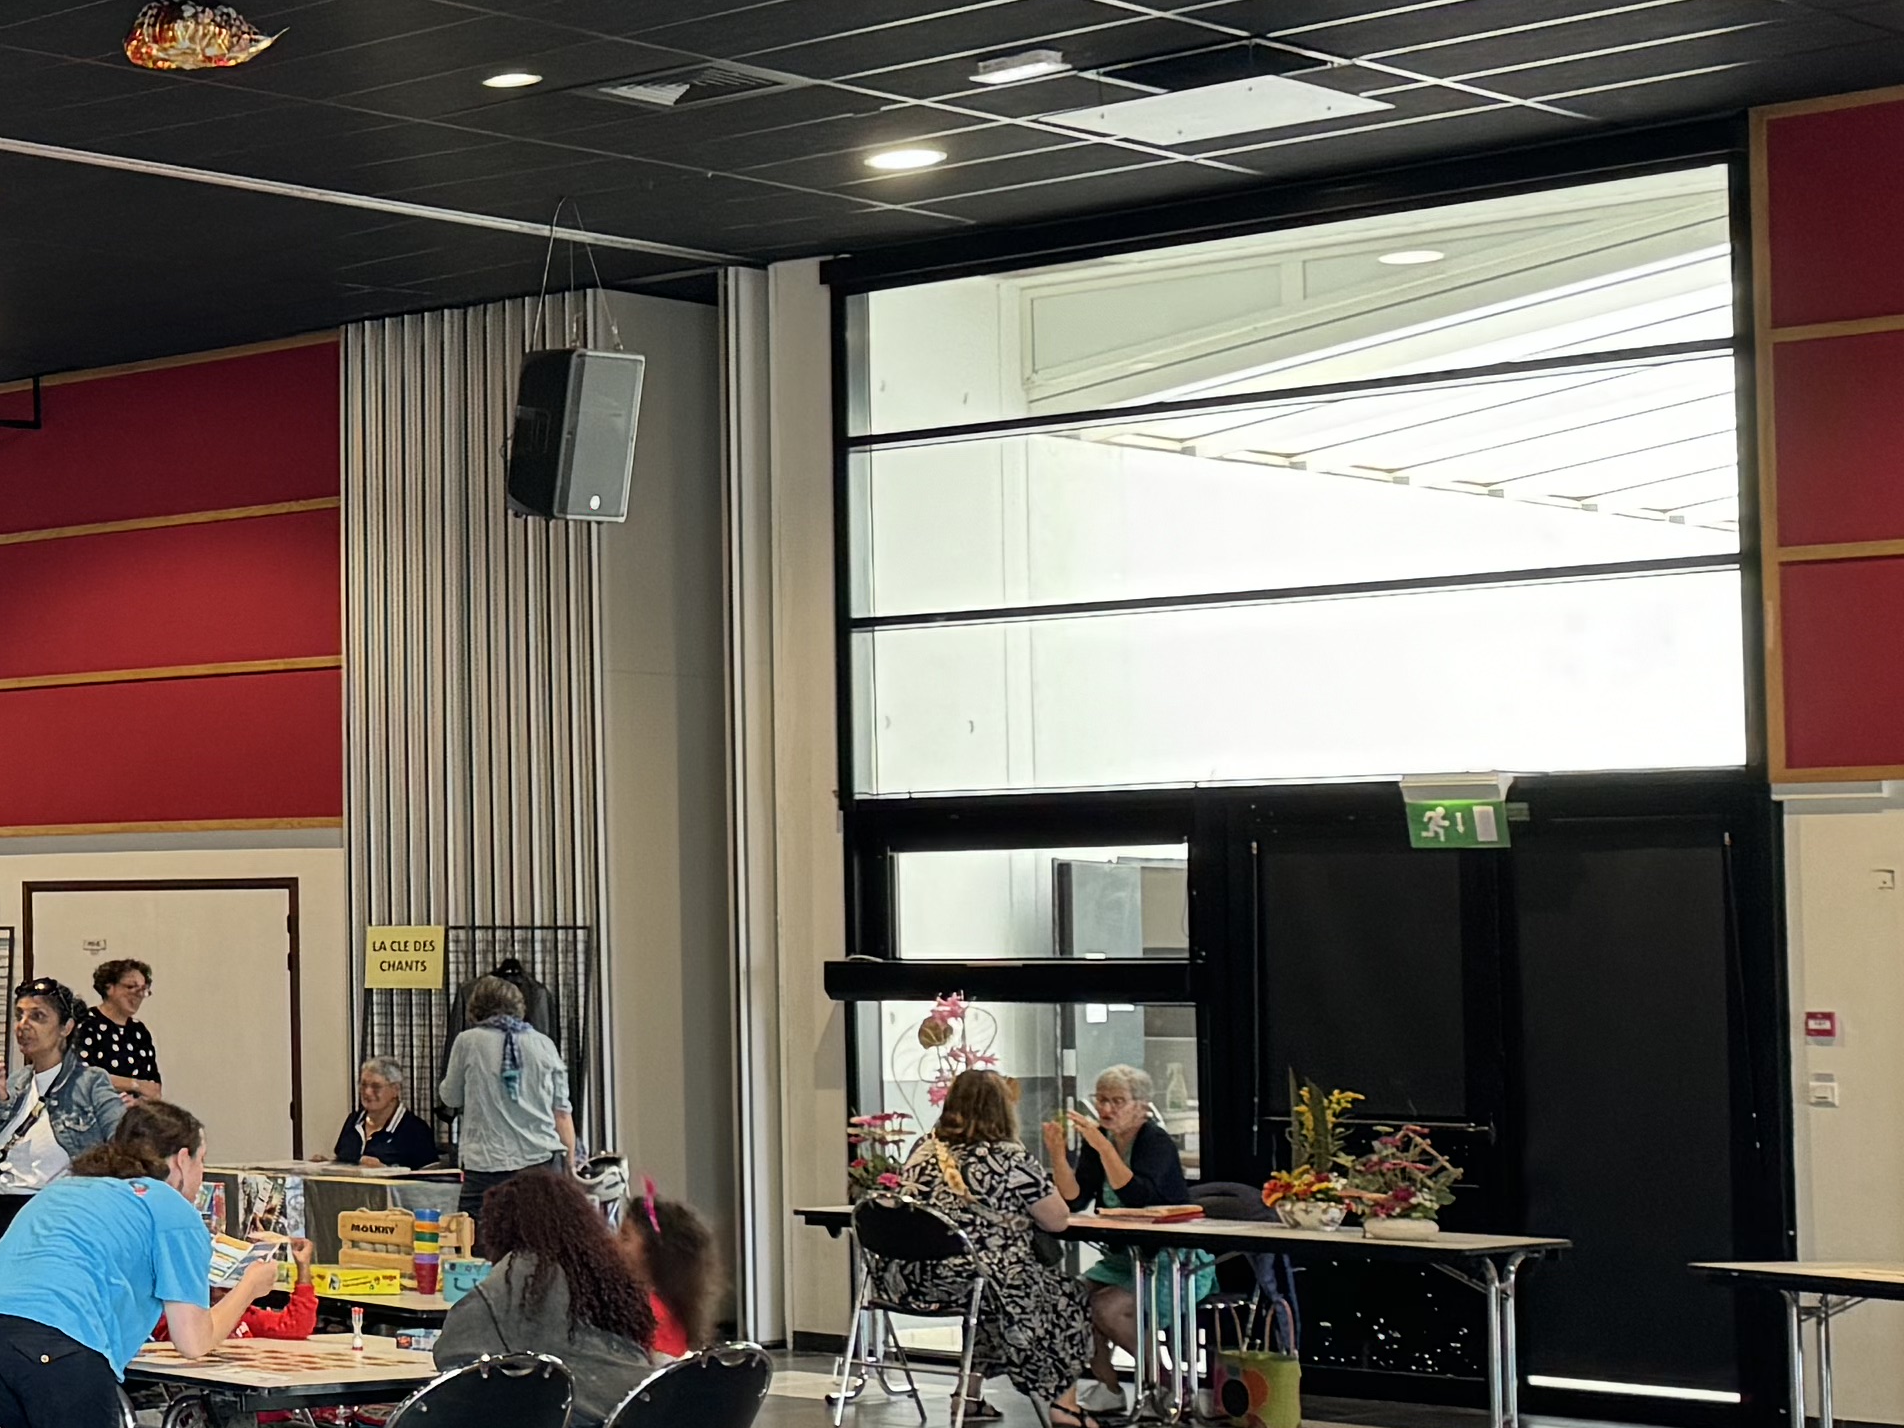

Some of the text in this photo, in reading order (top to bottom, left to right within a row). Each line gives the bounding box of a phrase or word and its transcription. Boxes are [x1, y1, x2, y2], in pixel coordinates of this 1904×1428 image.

[372, 940, 387, 952] LA
[413, 939, 436, 952] DES
[379, 960, 427, 972] CHANTS
